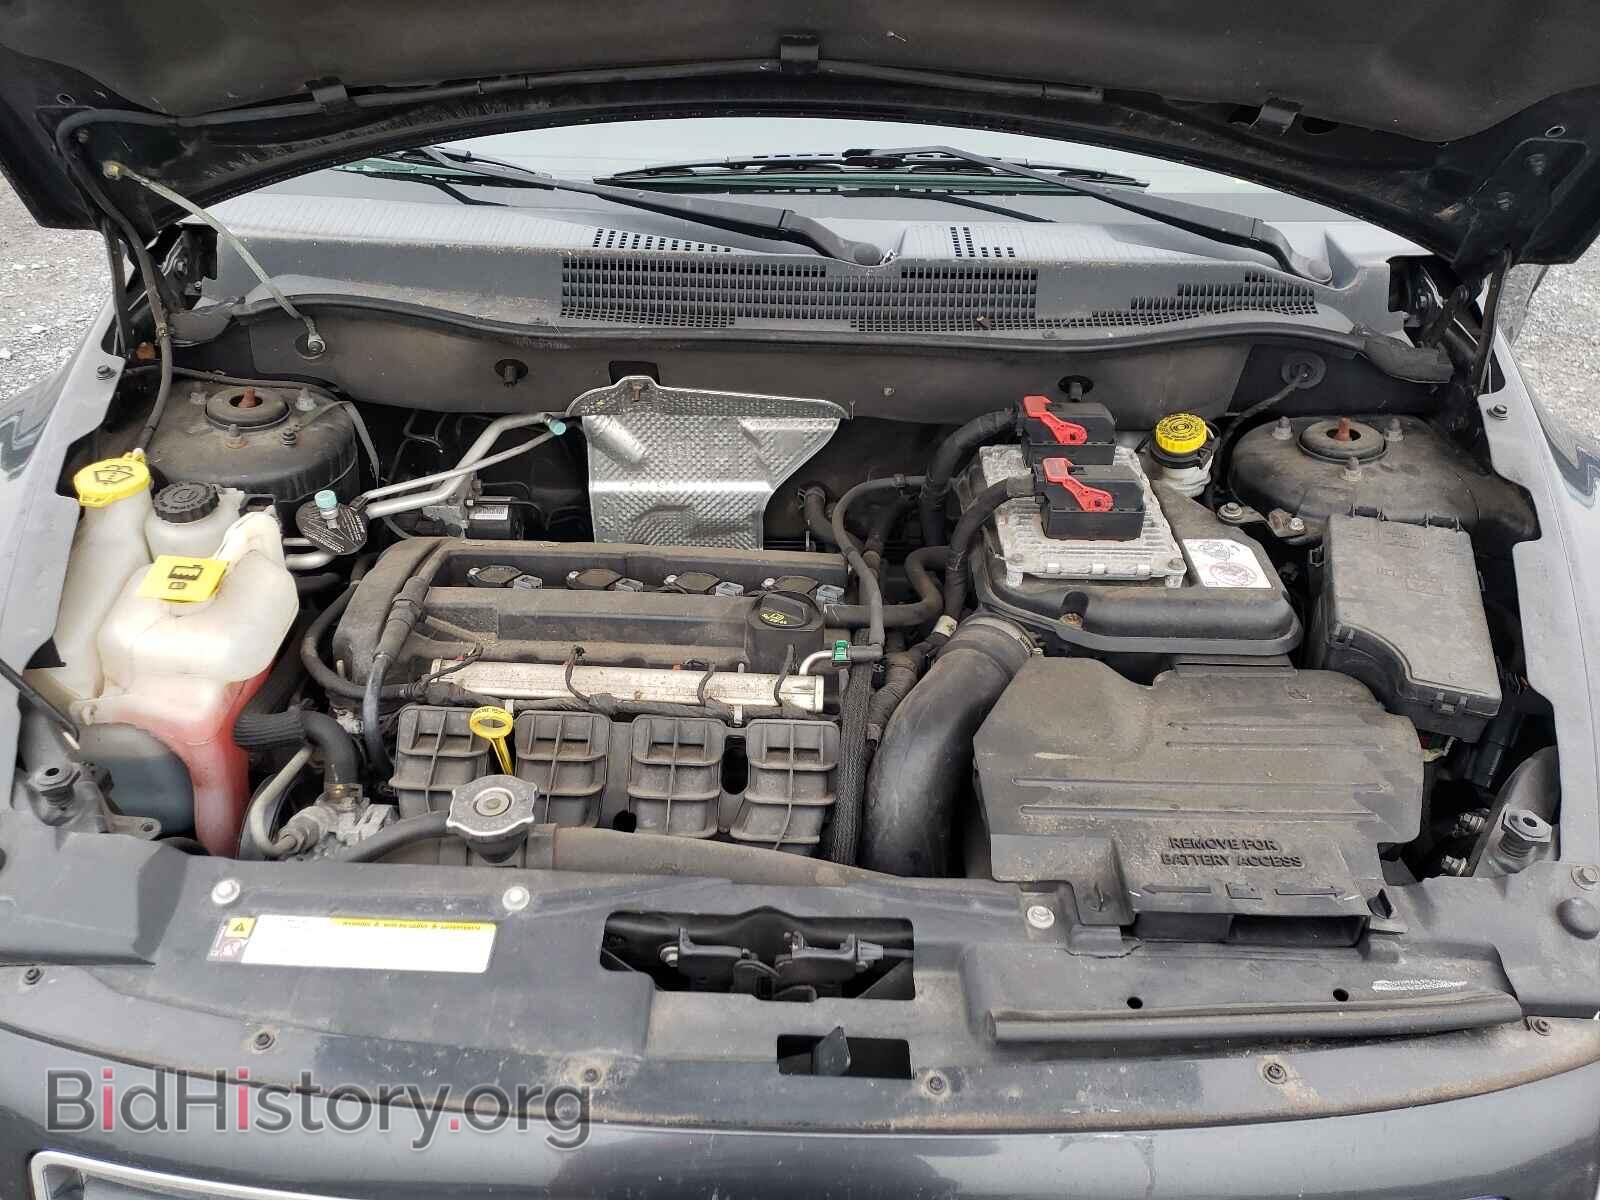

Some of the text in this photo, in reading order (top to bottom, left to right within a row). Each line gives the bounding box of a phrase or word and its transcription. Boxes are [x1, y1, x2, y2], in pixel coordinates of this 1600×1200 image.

[1168, 837, 1279, 851] REMOVE FOR
[1160, 854, 1304, 868] BATTERY ACCESS
